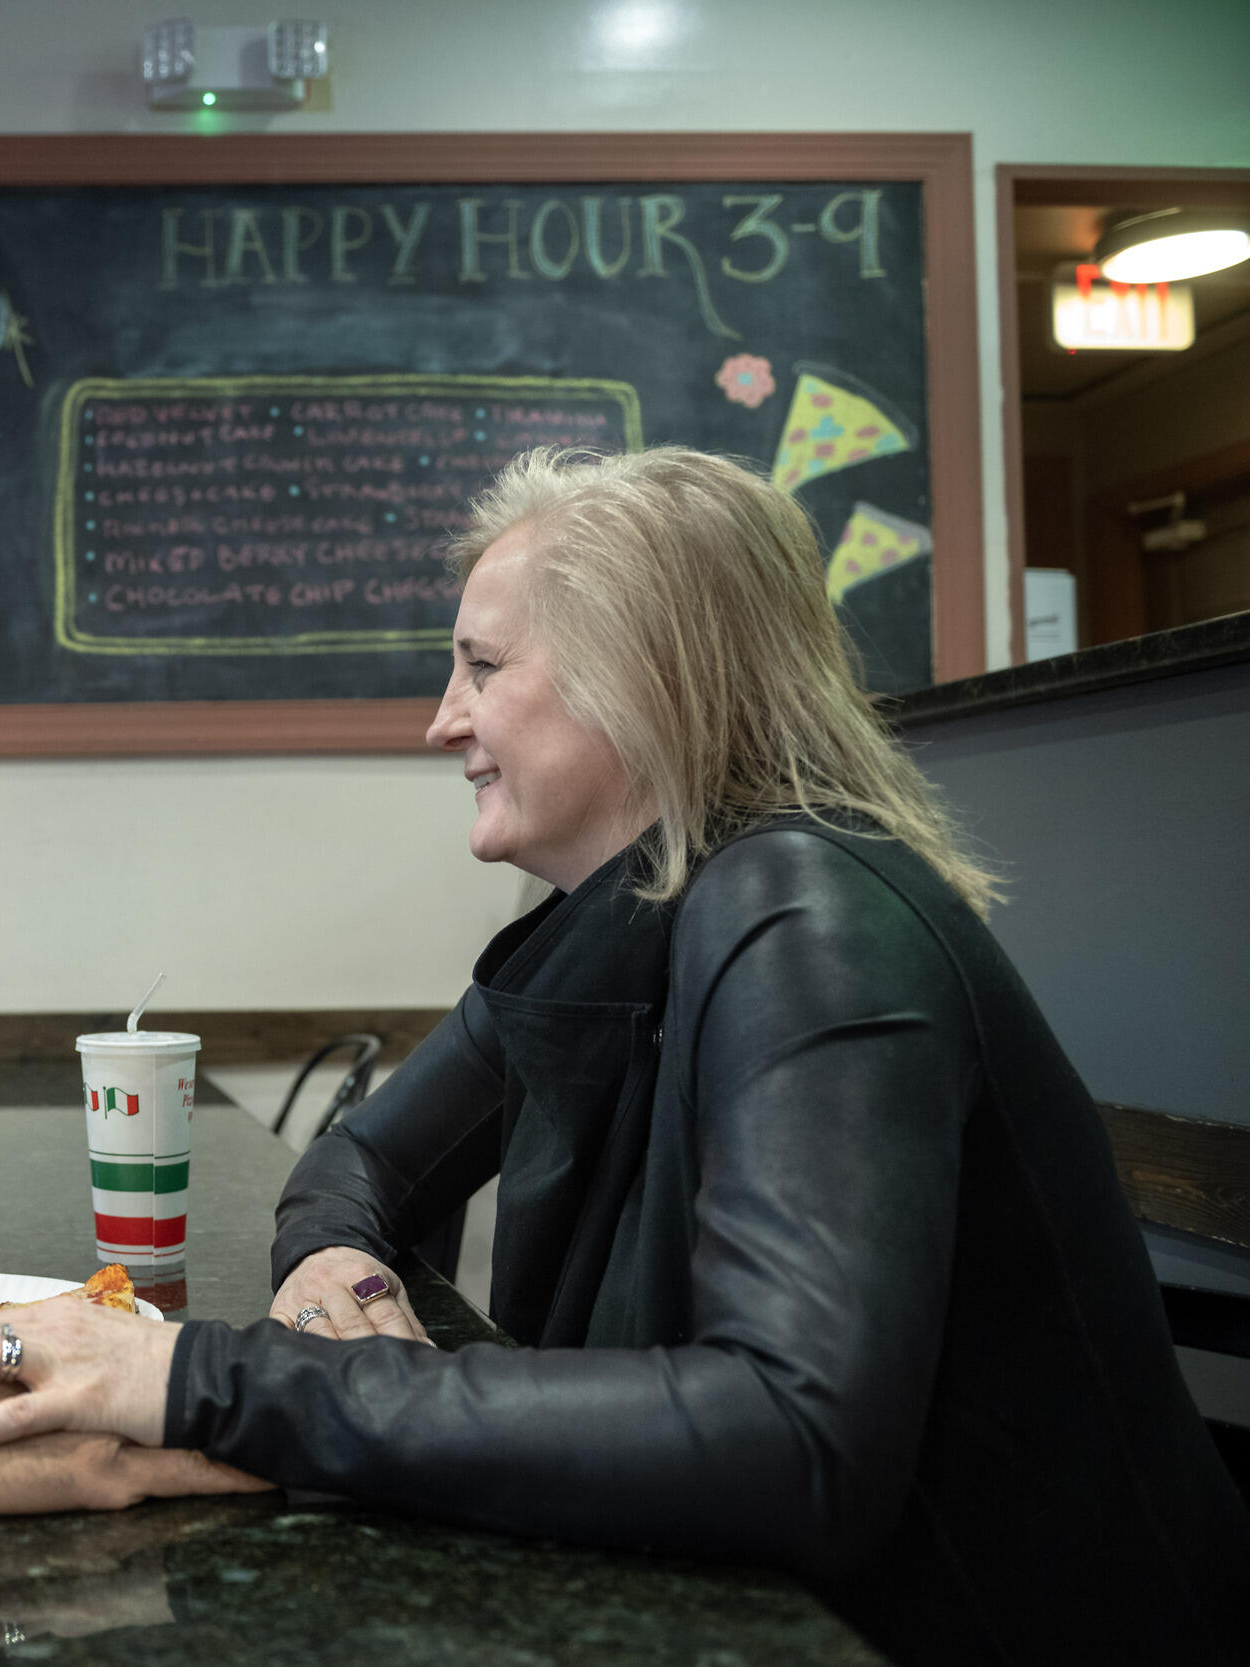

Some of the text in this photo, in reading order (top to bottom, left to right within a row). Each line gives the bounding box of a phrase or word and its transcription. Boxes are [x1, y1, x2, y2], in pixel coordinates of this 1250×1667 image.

[158, 190, 888, 340] HAPPY HOUR 3-9
[216, 542, 307, 572] BERRY
[104, 580, 281, 611] CHOCOLATE
[288, 578, 355, 607] CHIP
